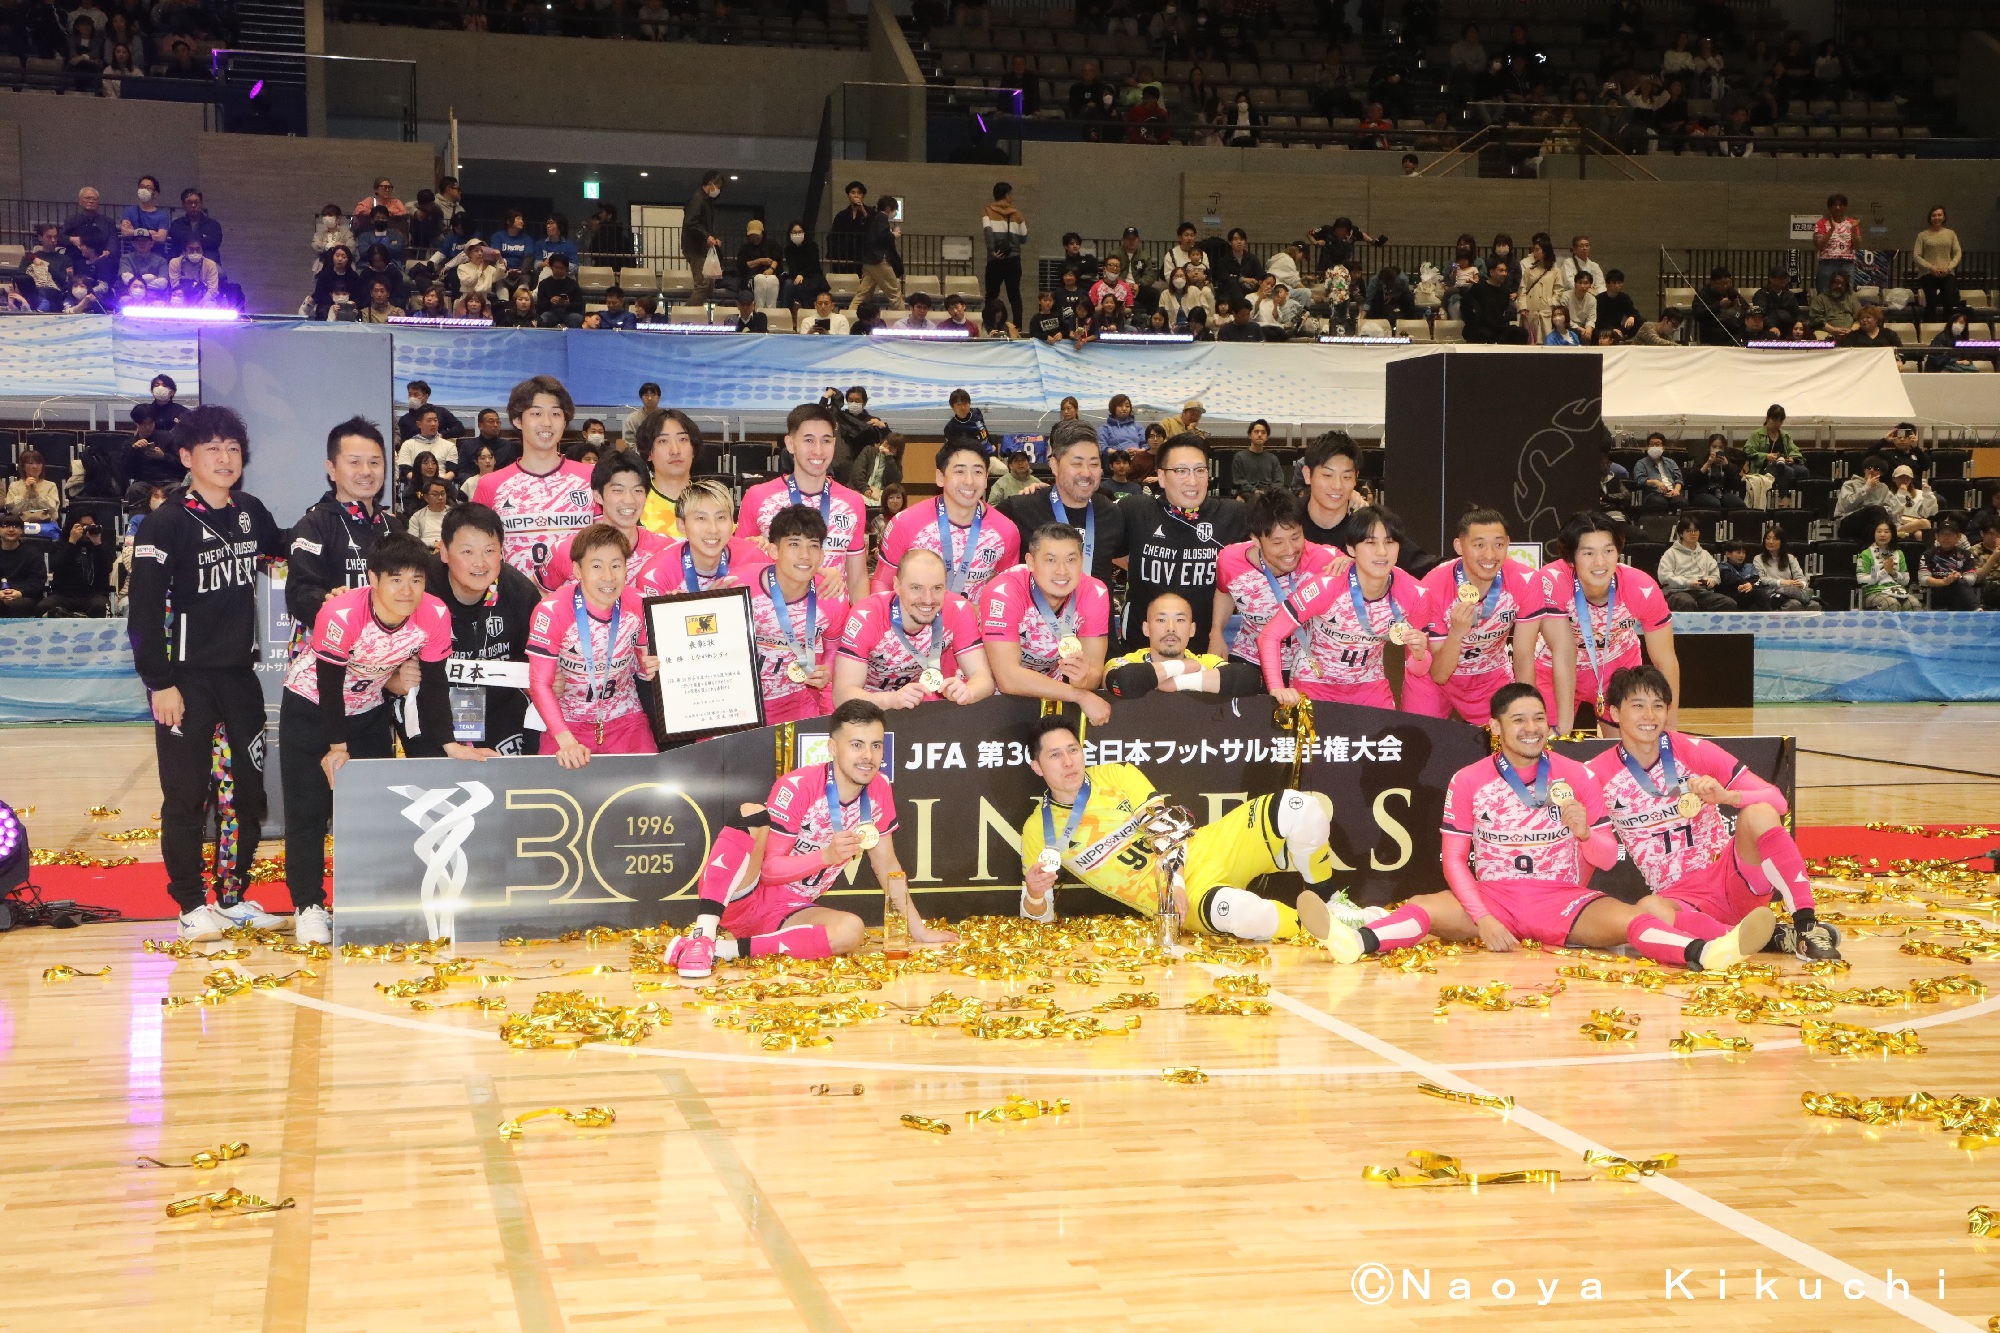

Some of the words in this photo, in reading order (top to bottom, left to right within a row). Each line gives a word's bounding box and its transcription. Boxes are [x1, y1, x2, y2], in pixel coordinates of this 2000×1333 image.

[1142, 543, 1178, 560] CHERRY
[1182, 547, 1218, 560] BLOSSOM
[769, 572, 777, 588] JFA
[1141, 556, 1217, 586] LOVERS
[575, 594, 583, 610] JFA
[892, 605, 900, 620] JFA
[449, 662, 507, 683] 日本一
[1661, 734, 1669, 750] JFA
[905, 742, 967, 770] JFA
[1498, 757, 1509, 772] JFA
[626, 815, 675, 836] 1996
[1477, 826, 1570, 842] NIPPONRIKO
[1075, 817, 1142, 868] NIPPONRIK
[625, 854, 674, 875] 2025
[1514, 854, 1534, 875] 9
